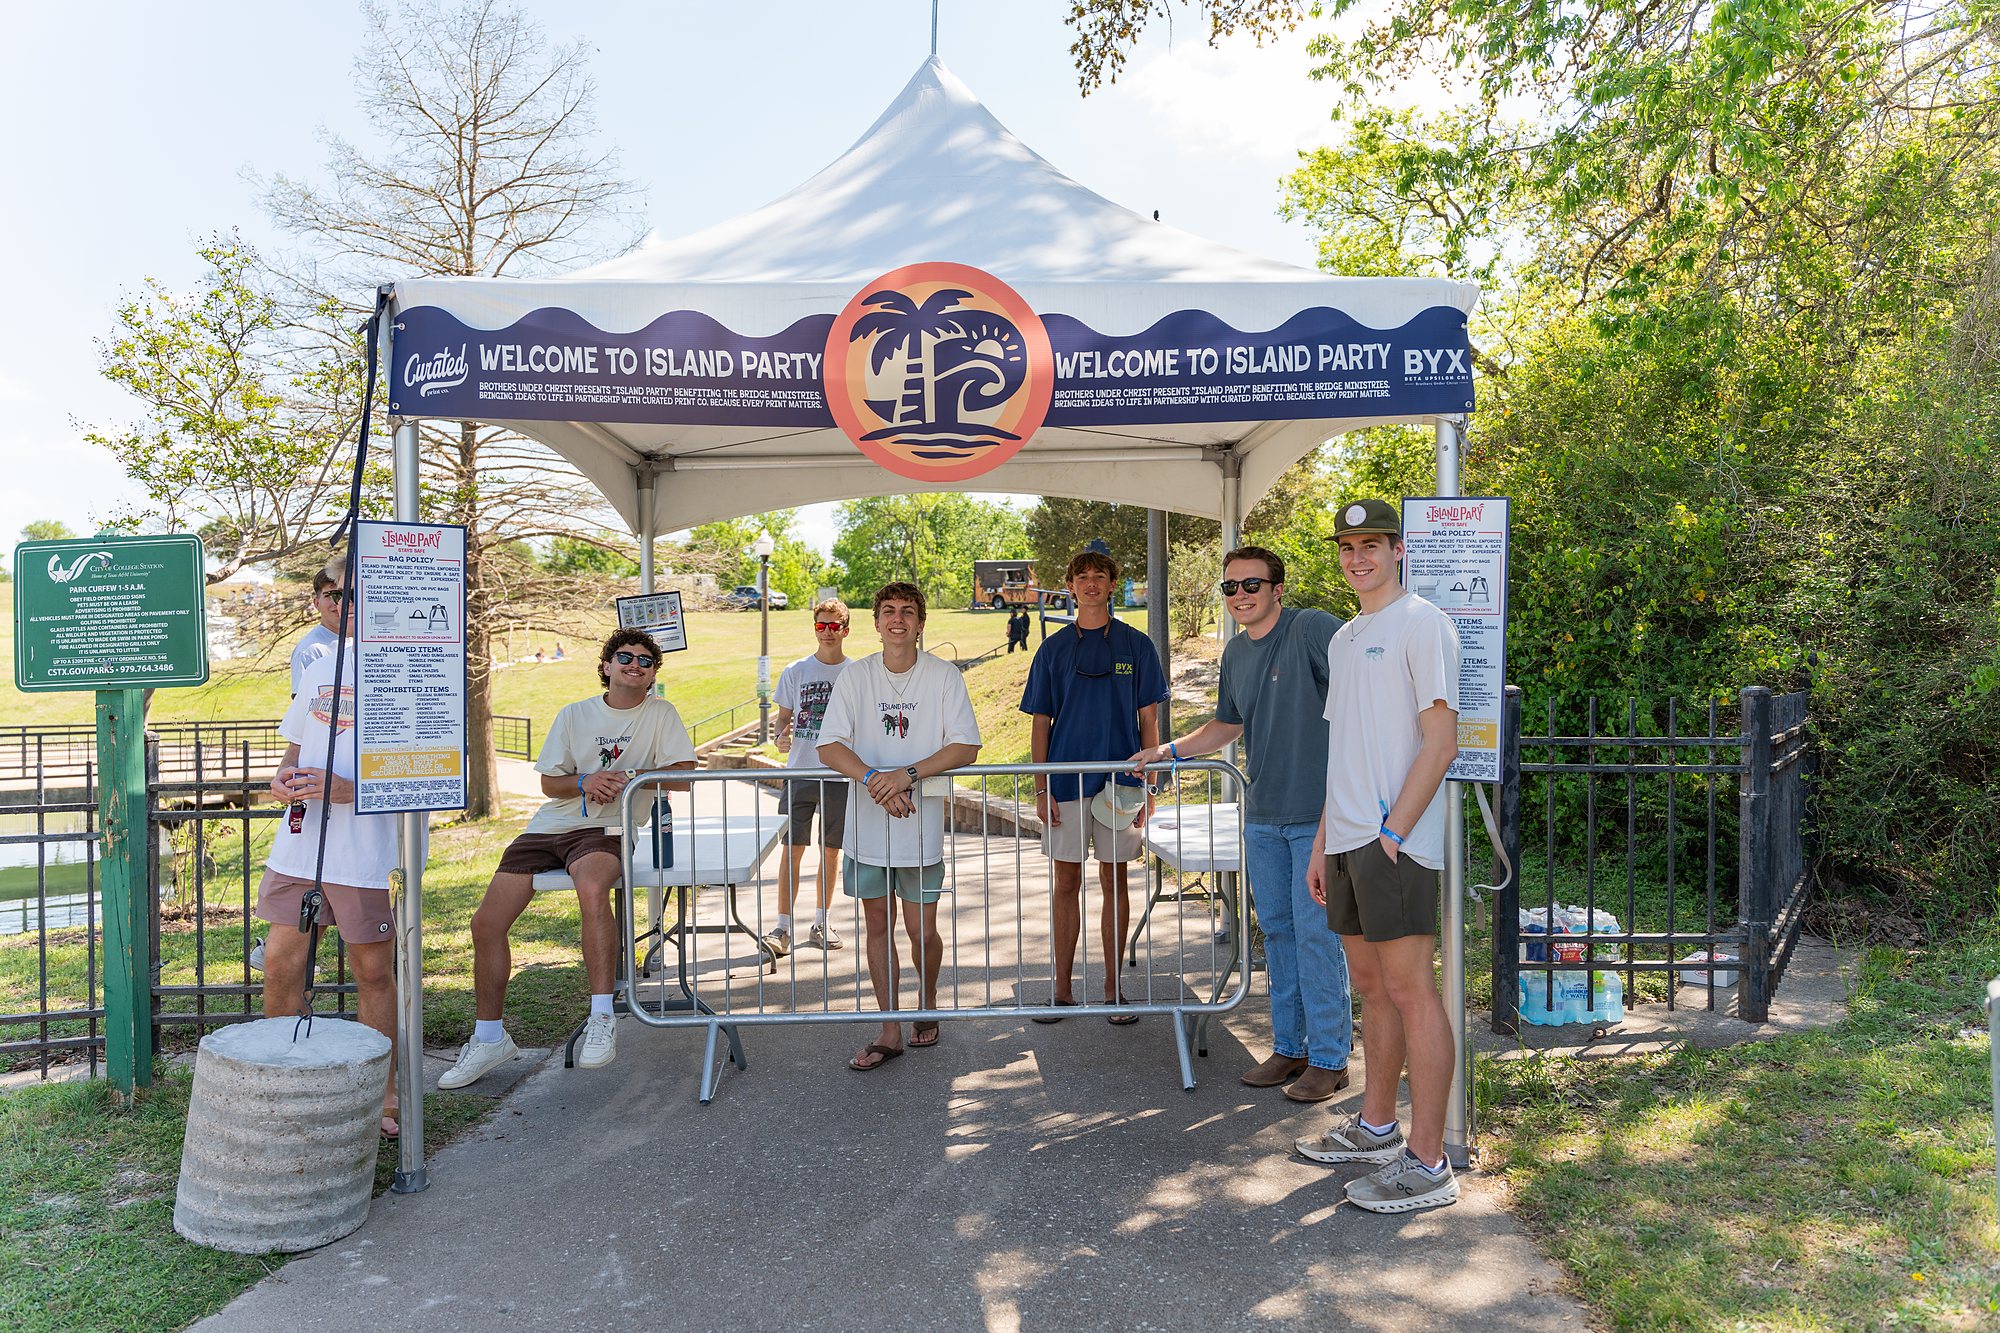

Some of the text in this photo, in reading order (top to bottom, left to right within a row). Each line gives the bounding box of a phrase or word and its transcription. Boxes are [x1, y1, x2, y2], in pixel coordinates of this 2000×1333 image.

[404, 343, 468, 387] Curated
[480, 344, 821, 380] WELCOME TO ISLAND PARTY
[1056, 344, 1391, 379] WELCOME TO ISLAND PARTY
[1404, 350, 1468, 374] BYX
[479, 383, 822, 400] BROTHERS UNDER CHRIST PRESENTS "ISLAND PARTY" BENEFITING THE BRIDGE MINISTRIES.
[1055, 381, 1390, 399] BROTHERS UNDER CHRIST PRESENTS "ISLAND PARTY" BENEFITING THE BRIDGE MINISTRIES.
[1055, 399, 1090, 408] BRINGING
[1092, 398, 1114, 407] IDEAS
[1116, 398, 1125, 406] TO
[1126, 398, 1142, 406] LIFE
[1154, 396, 1199, 405] PARTNERSHIP
[1200, 395, 1219, 404] WITH
[1221, 394, 1251, 403] CURATED
[1252, 394, 1272, 402] PRINT
[1286, 392, 1316, 401] BECAUSE
[1317, 392, 1337, 400] EVERY
[1339, 391, 1358, 399] PRINT
[1360, 390, 1390, 399] MATTERS.
[479, 392, 822, 409] BRINGING IDEAS TO LIFE IN PARTNERSHIP WITH CURATED PRINT CO. BECAUSE EVERY PRINT MATTERS.
[48, 664, 174, 676] CSTX.GOV/PARKS 979.764.3486
[1367, 1136, 1403, 1152] RUNNING
